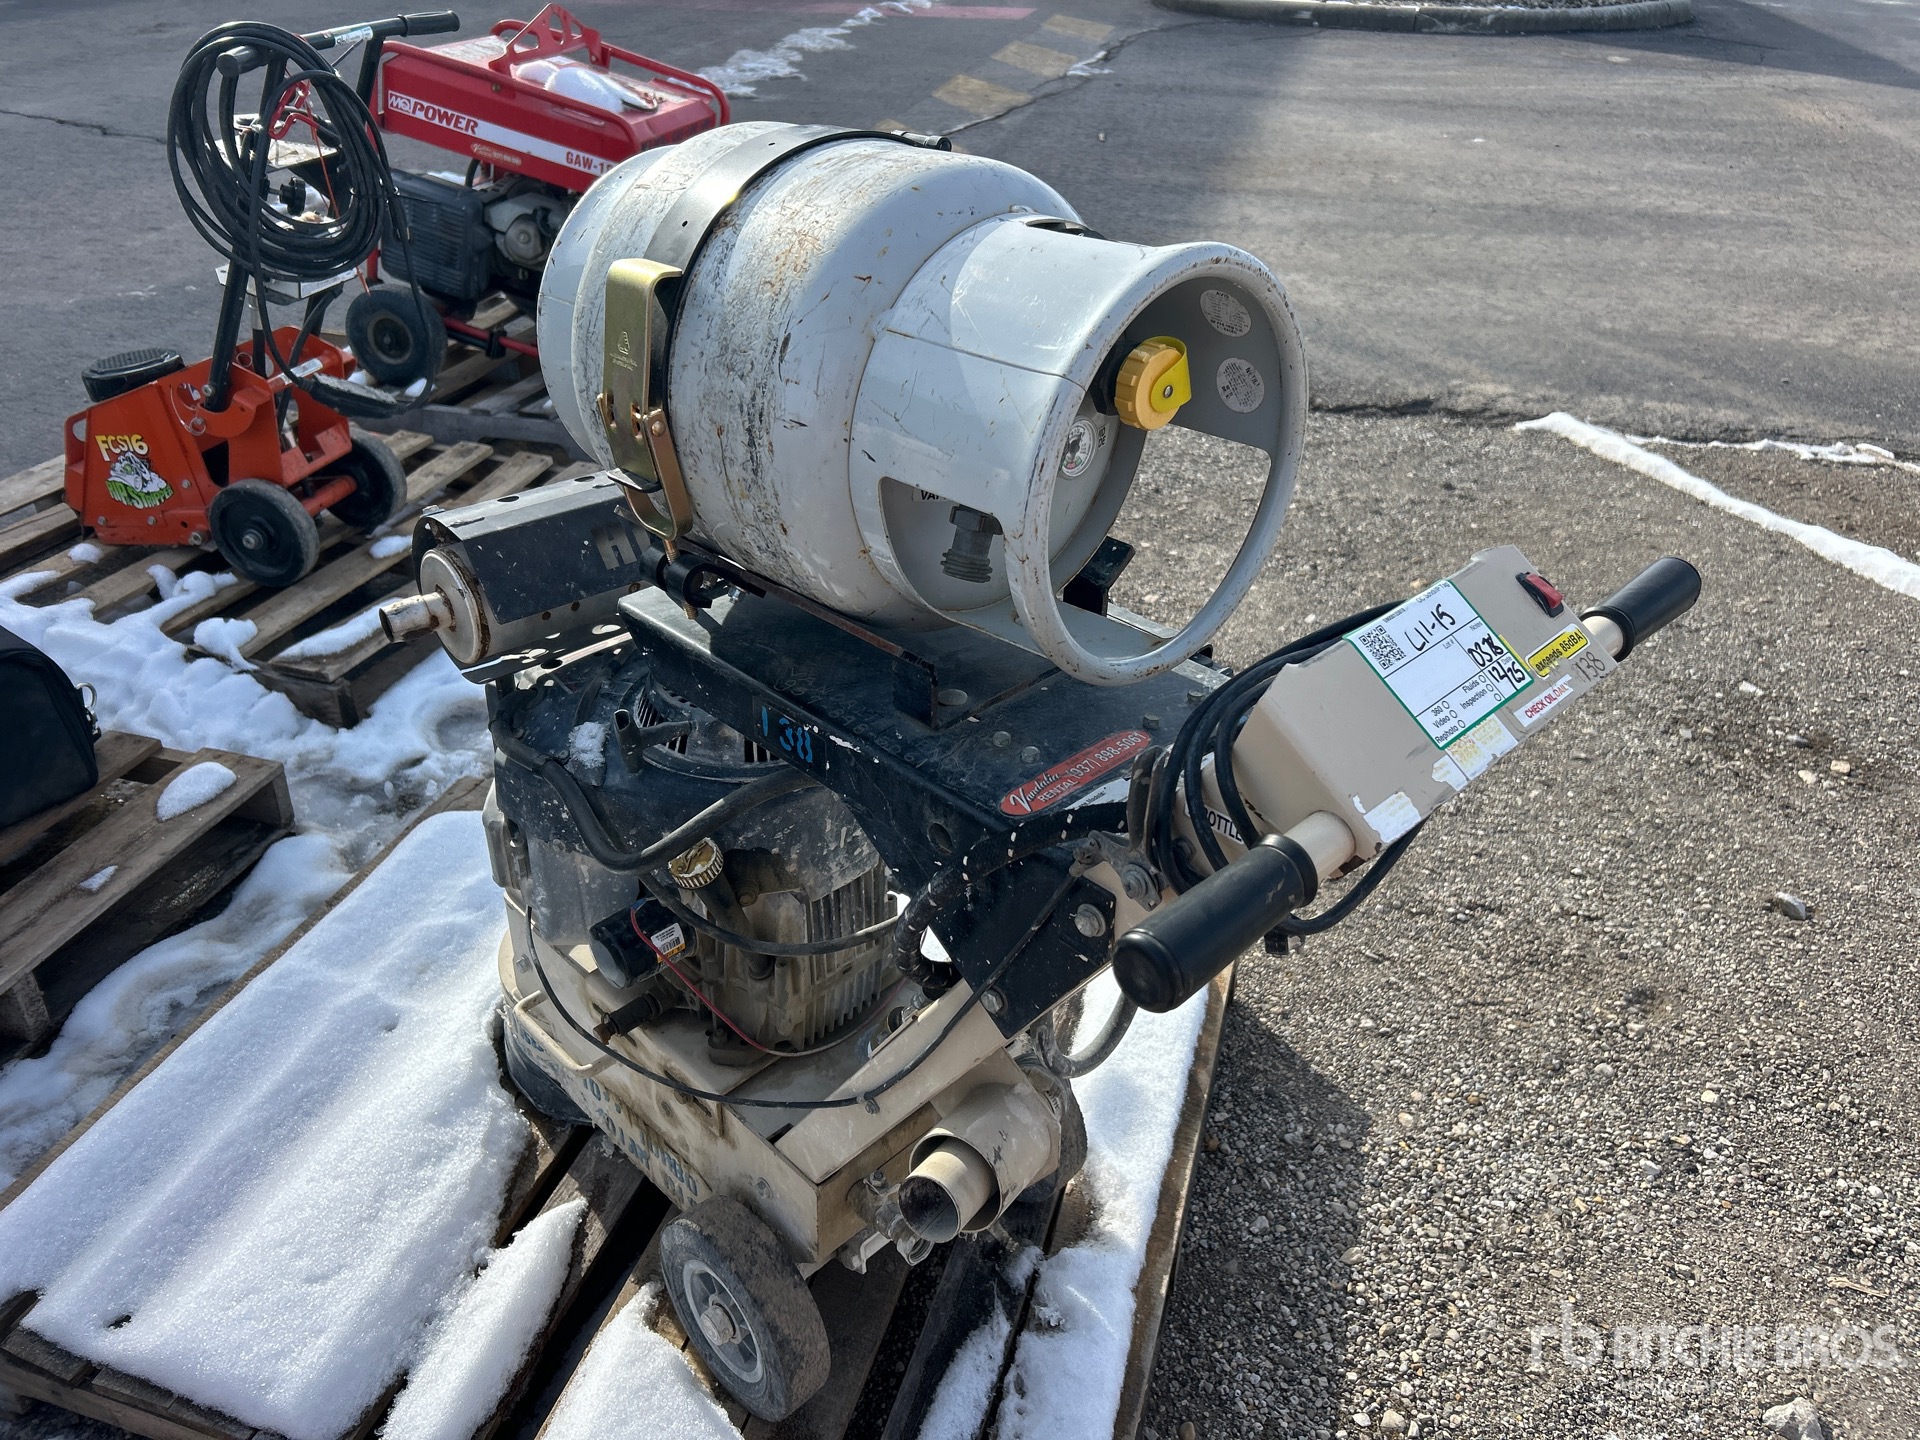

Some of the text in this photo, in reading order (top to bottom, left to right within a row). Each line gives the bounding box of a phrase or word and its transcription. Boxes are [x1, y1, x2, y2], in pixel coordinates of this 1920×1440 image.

[411, 101, 479, 136] POWER
[95, 434, 149, 462] FCS16
[1469, 620, 1483, 632] Notes
[1442, 640, 1452, 650] Lot
[1535, 631, 1584, 672] exceeds 85dBA
[1462, 679, 1480, 694] Fluids
[1460, 689, 1488, 710] Inspection
[1524, 682, 1570, 719] CHECK OIL DAIL
[1431, 706, 1444, 718] 360
[1433, 715, 1451, 729] Video
[1434, 725, 1459, 744] Rephoto
[1010, 773, 1060, 812] Vandalia
[1066, 758, 1102, 780] (937)
[1094, 731, 1147, 762] 898-5061
[1037, 779, 1079, 803] RENTAL
